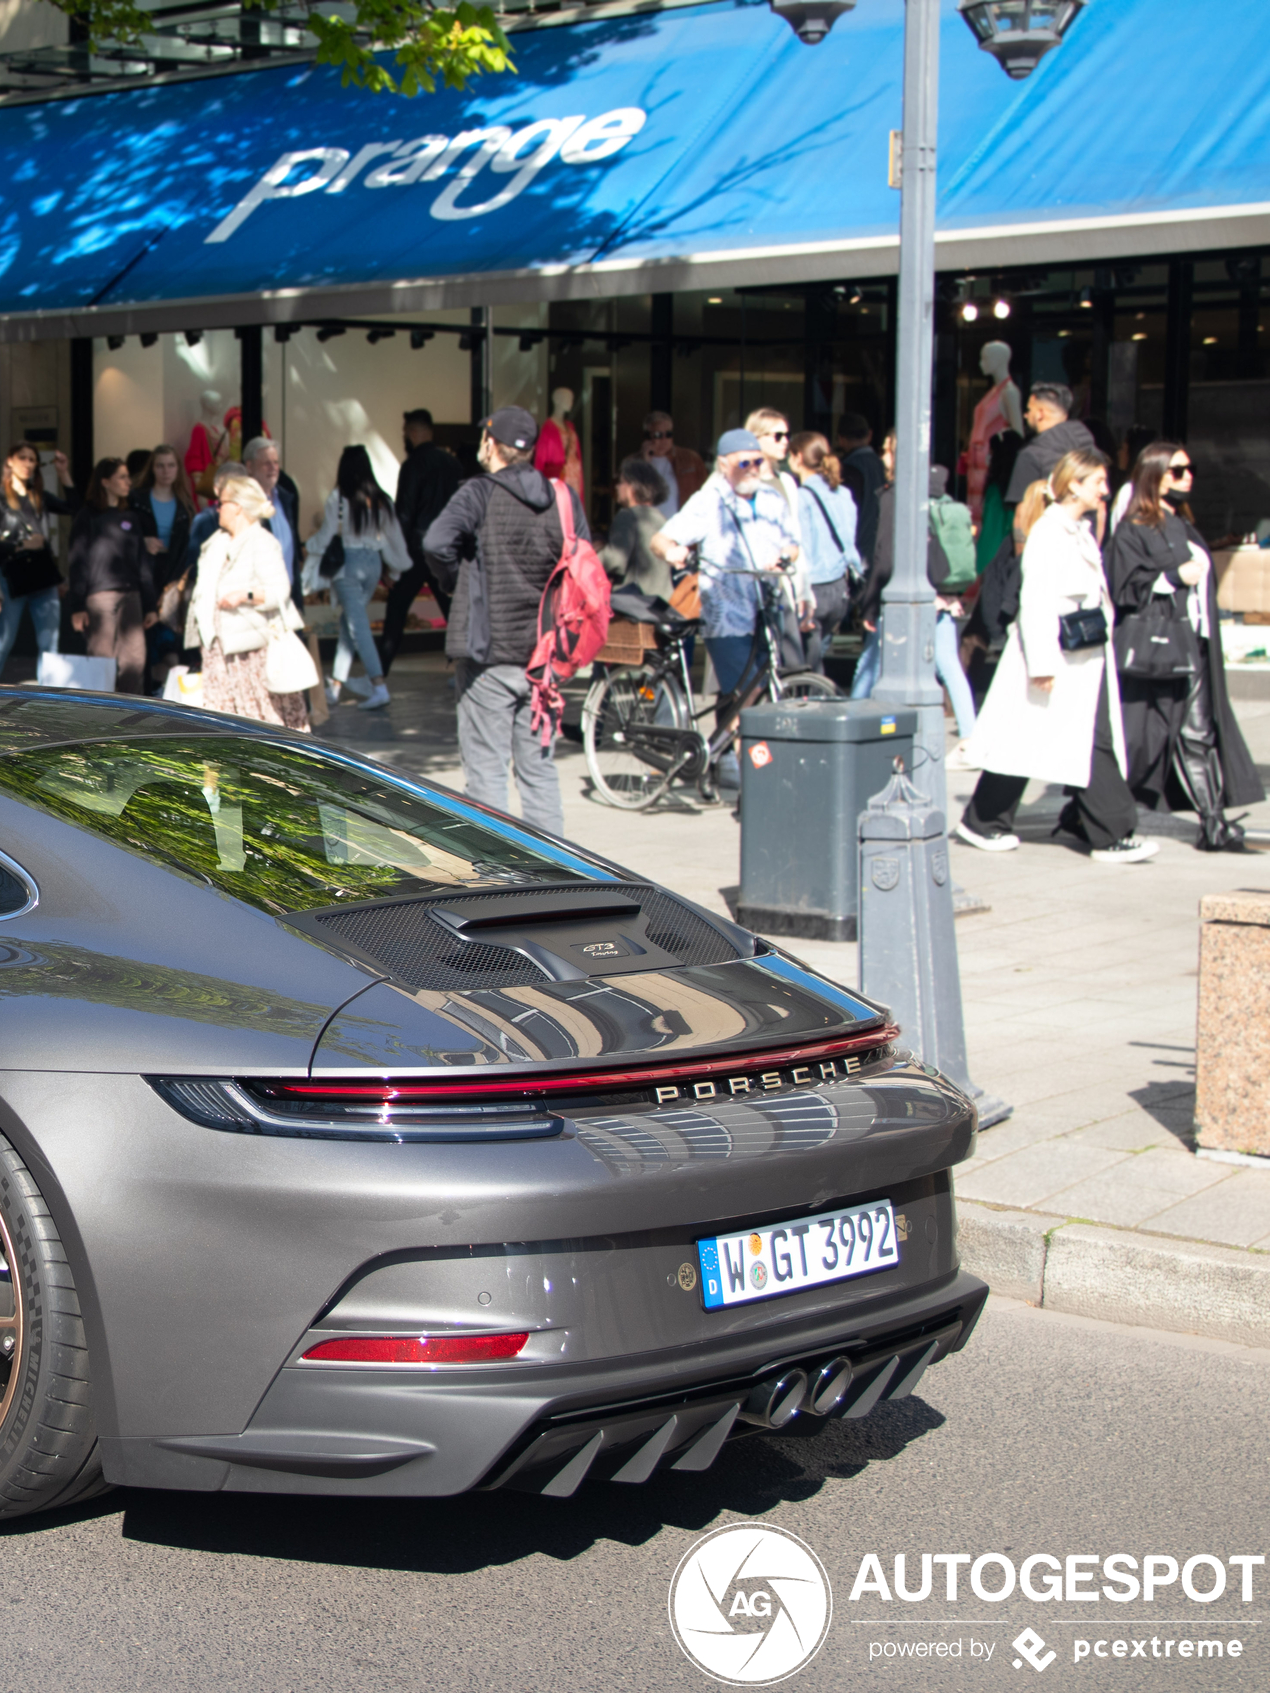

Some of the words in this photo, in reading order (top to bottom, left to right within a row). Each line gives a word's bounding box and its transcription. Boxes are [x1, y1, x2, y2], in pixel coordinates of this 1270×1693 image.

[203, 107, 647, 244] prange
[583, 942, 615, 952] GT3
[656, 1057, 861, 1104] PORSCHE
[723, 1239, 745, 1293] W
[770, 1224, 809, 1282] GT
[817, 1206, 894, 1271] 3992
[709, 1279, 718, 1295] D
[2, 1349, 40, 1457] MICHELIN
